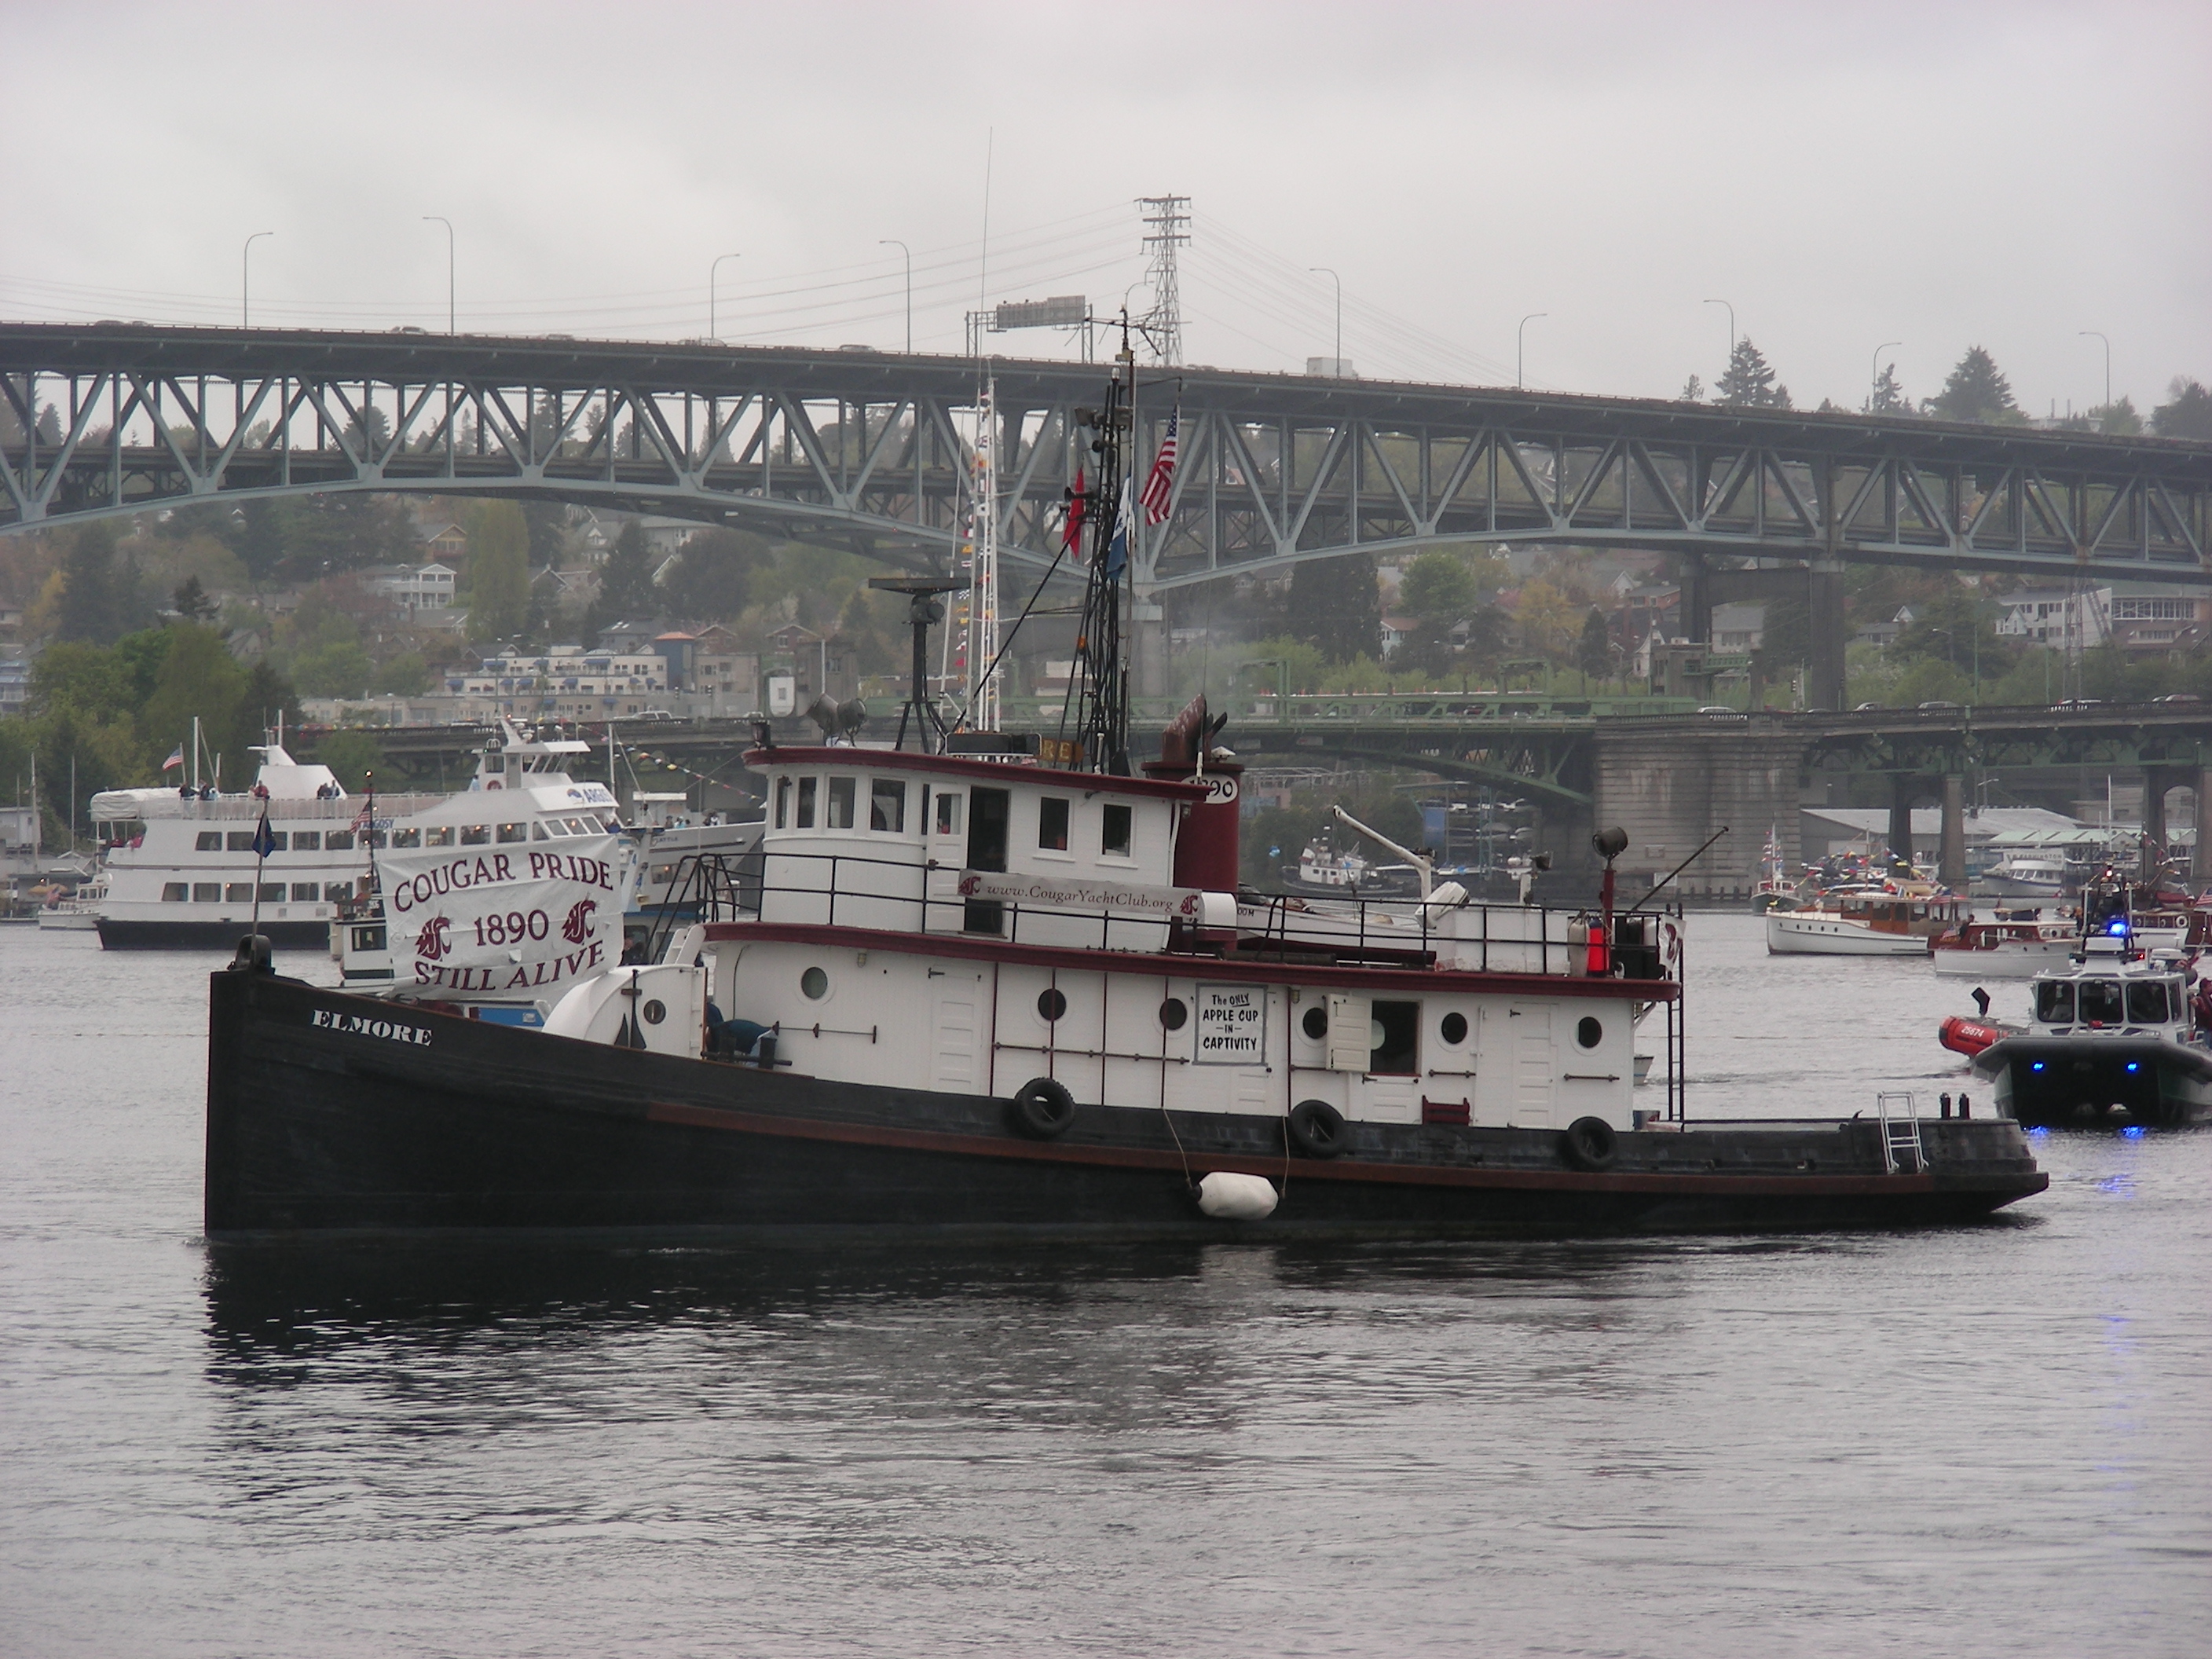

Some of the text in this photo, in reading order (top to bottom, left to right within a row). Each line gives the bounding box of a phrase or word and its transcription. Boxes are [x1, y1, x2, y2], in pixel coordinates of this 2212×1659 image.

[394, 852, 613, 912] COUGAR PRIDE
[987, 885, 1173, 912] www.CougarYachtClub.org
[474, 909, 549, 947] 1890
[414, 939, 605, 991] STILL ALIVE
[1203, 1009, 1258, 1021] APPLE CUP
[1212, 993, 1250, 1006] The ONLY
[312, 1009, 433, 1047] ELMORE
[1203, 1037, 1257, 1050] CAPTIVITY
